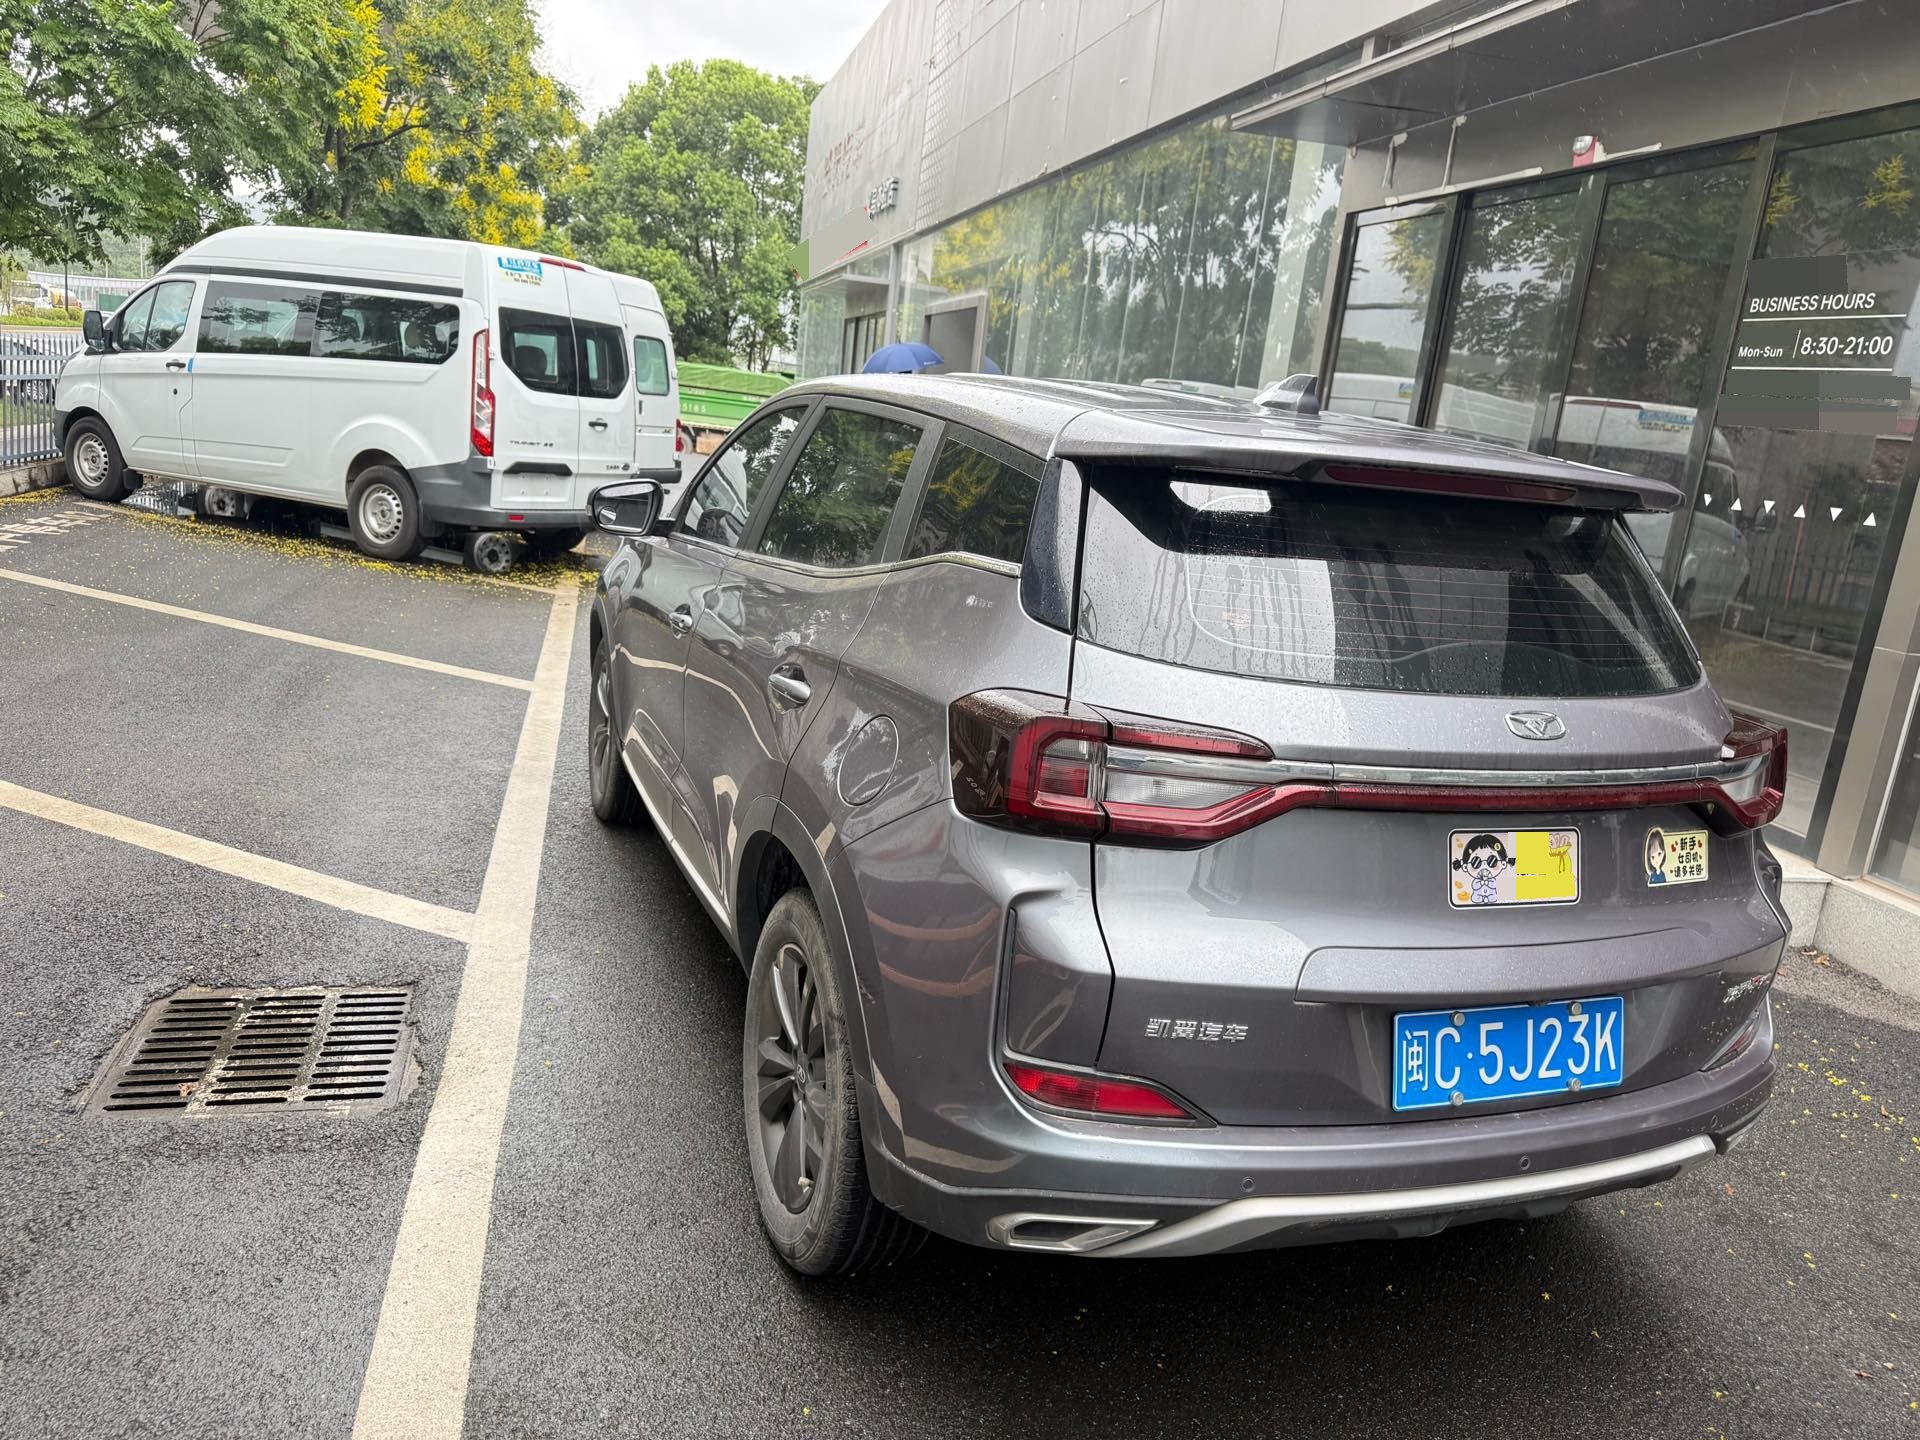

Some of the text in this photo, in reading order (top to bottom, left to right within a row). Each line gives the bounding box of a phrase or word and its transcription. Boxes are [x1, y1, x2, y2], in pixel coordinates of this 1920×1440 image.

[1749, 292, 1876, 313] BUSINESS HOURS
[1737, 335, 1894, 358] Mon-Sun 8:30-21:00
[1679, 836, 1697, 851] 新手
[1678, 851, 1699, 864] 女司机
[1144, 1018, 1249, 1042] 凯翼汽车
